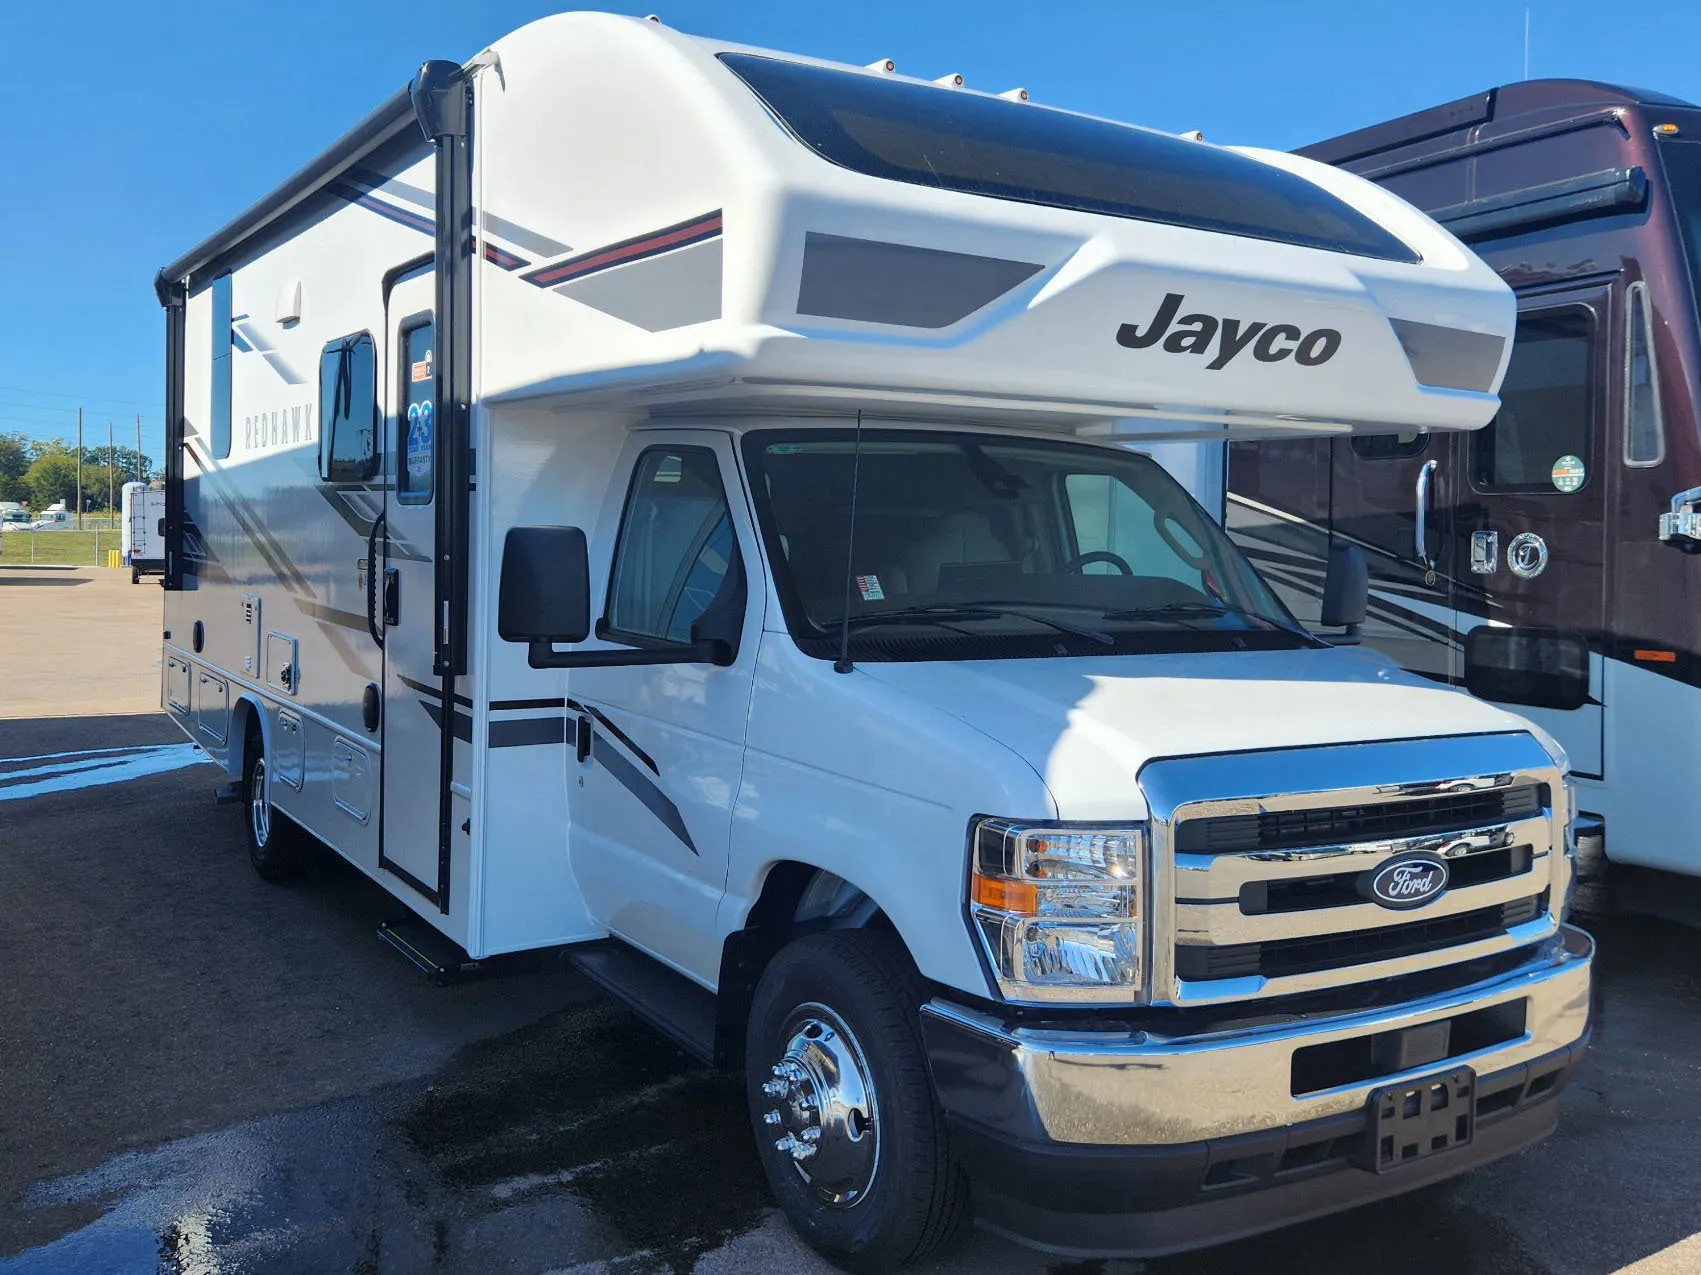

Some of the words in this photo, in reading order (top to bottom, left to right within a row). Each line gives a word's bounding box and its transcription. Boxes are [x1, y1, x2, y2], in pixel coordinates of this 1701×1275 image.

[1116, 293, 1342, 370] Jayco
[245, 403, 313, 449] REDHAWK
[1388, 866, 1434, 897] Ford
